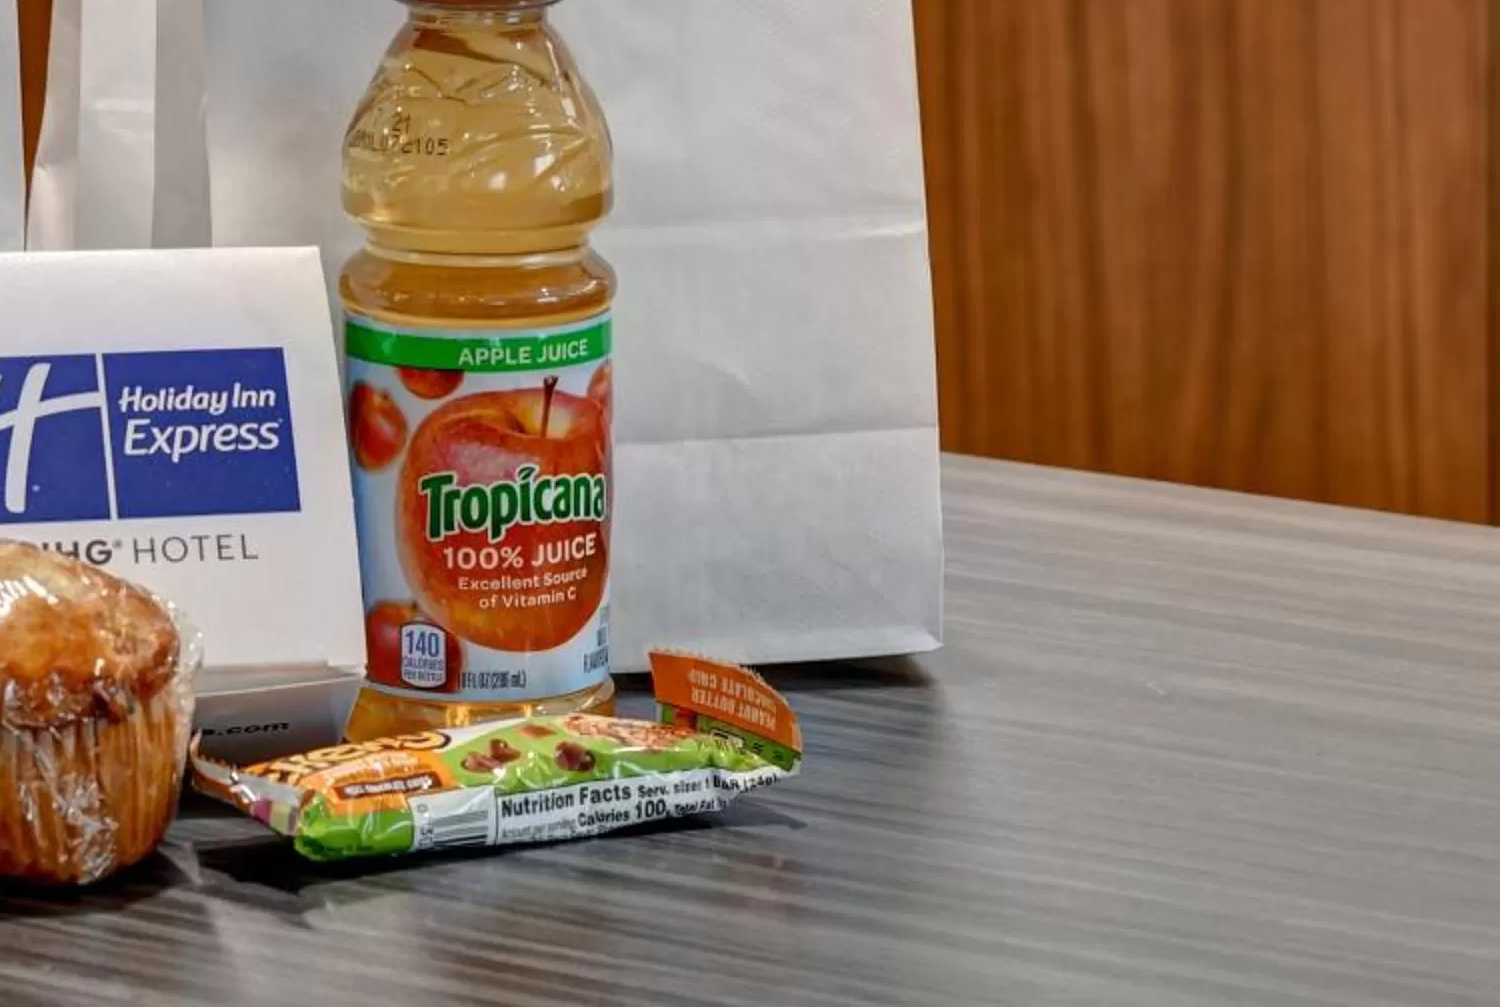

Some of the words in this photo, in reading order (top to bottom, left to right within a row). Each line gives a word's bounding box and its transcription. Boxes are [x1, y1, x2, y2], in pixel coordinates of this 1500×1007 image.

[458, 346, 533, 366] APPLE
[536, 338, 589, 363] JUICE
[118, 382, 228, 415] Holiday
[231, 381, 277, 409] Inn
[123, 418, 281, 463] Express
[419, 466, 606, 540] Tropicana
[133, 534, 259, 564] HOTEL
[443, 546, 524, 570] 100%
[531, 533, 597, 567] JUICE
[458, 575, 540, 591] Excellent
[542, 568, 589, 588] Source
[479, 596, 499, 610] of
[502, 590, 565, 608] Vitamin
[567, 588, 577, 601] C
[404, 630, 440, 658] 140
[692, 686, 736, 714] BUTTER
[501, 792, 575, 818] Nutrition
[579, 783, 632, 807] Facts
[577, 809, 630, 827] Calories
